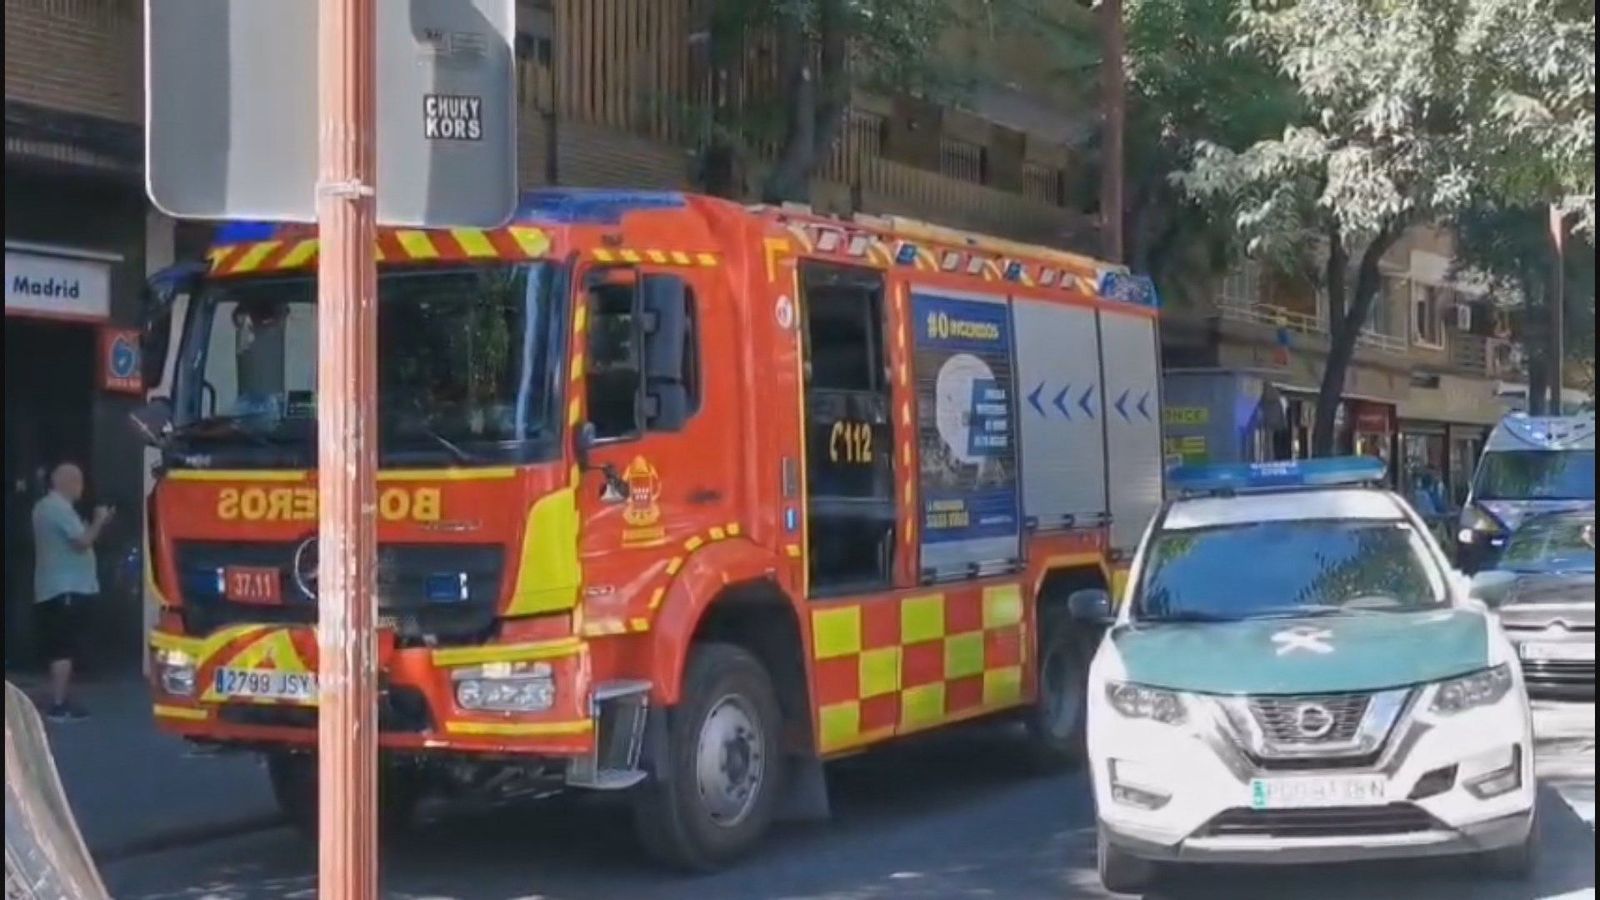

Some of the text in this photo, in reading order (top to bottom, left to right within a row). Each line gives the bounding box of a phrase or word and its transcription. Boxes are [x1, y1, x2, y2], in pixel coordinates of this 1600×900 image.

[426, 97, 479, 118] CHUKY
[426, 118, 480, 138] KORS
[13, 276, 80, 299] Madrid
[845, 421, 872, 462] 112
[234, 572, 271, 597] 37.11
